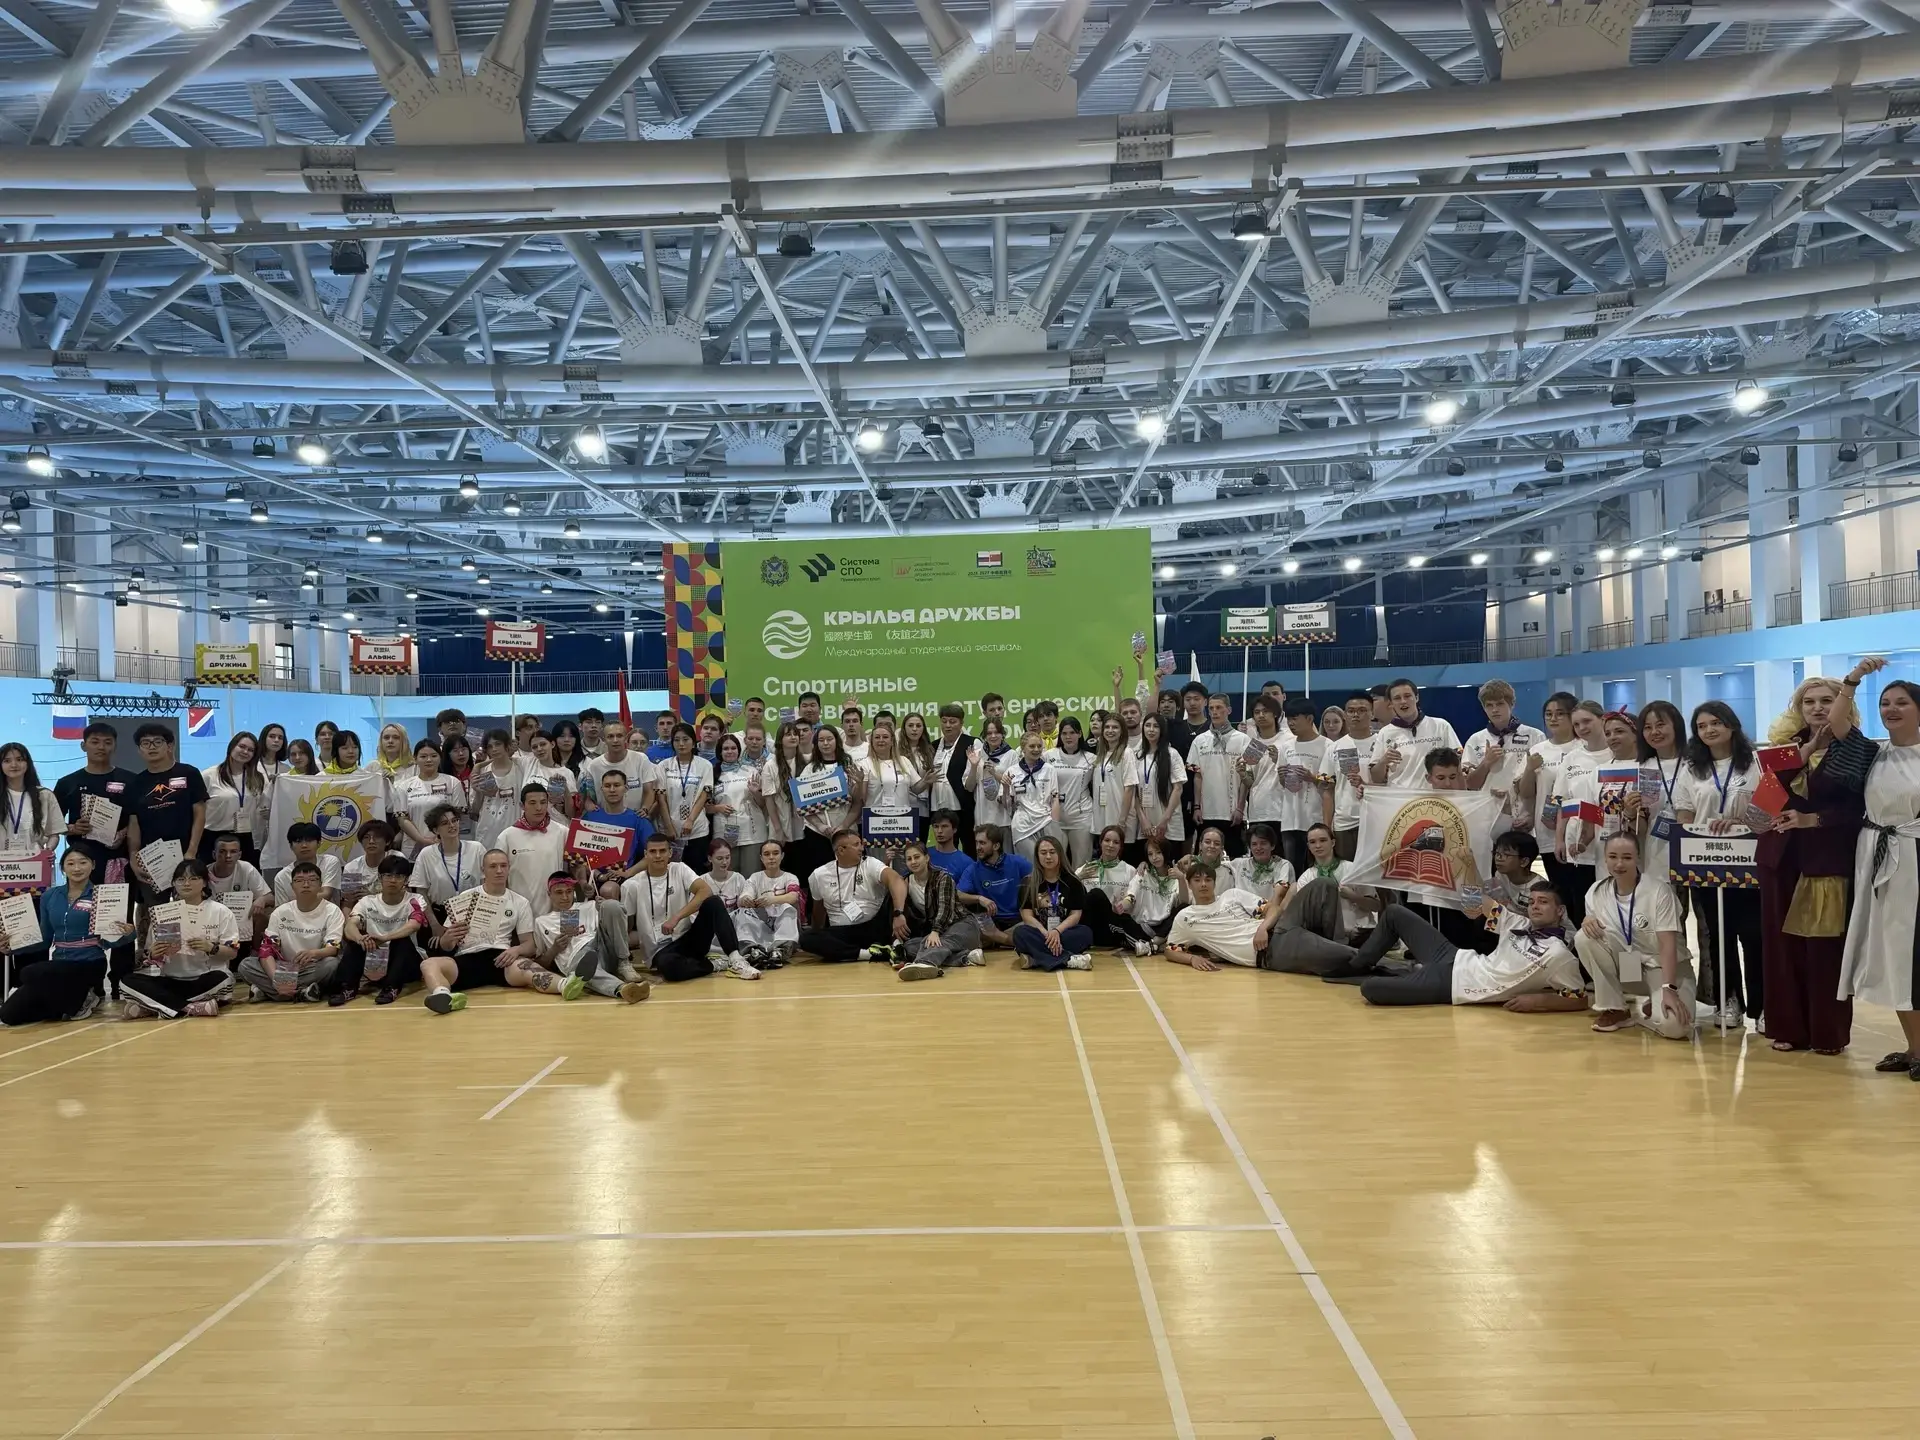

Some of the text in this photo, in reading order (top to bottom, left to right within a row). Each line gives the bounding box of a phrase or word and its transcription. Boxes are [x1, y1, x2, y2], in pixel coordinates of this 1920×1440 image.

[840, 557, 880, 566] Система
[840, 567, 863, 576] СПО
[824, 605, 1021, 626] КРЫЛЬЯ ДРУЖБЫ
[1291, 621, 1321, 629] СОКОЛЫ
[824, 643, 1022, 657] Международный студенческий фестиваль
[763, 676, 917, 696] Спортивные
[803, 786, 839, 799] ЕДИНСТВО
[1400, 800, 1450, 819] МАШИНОСТРОЕНИЯ
[1688, 854, 1752, 863] ГРИФОНЫ
